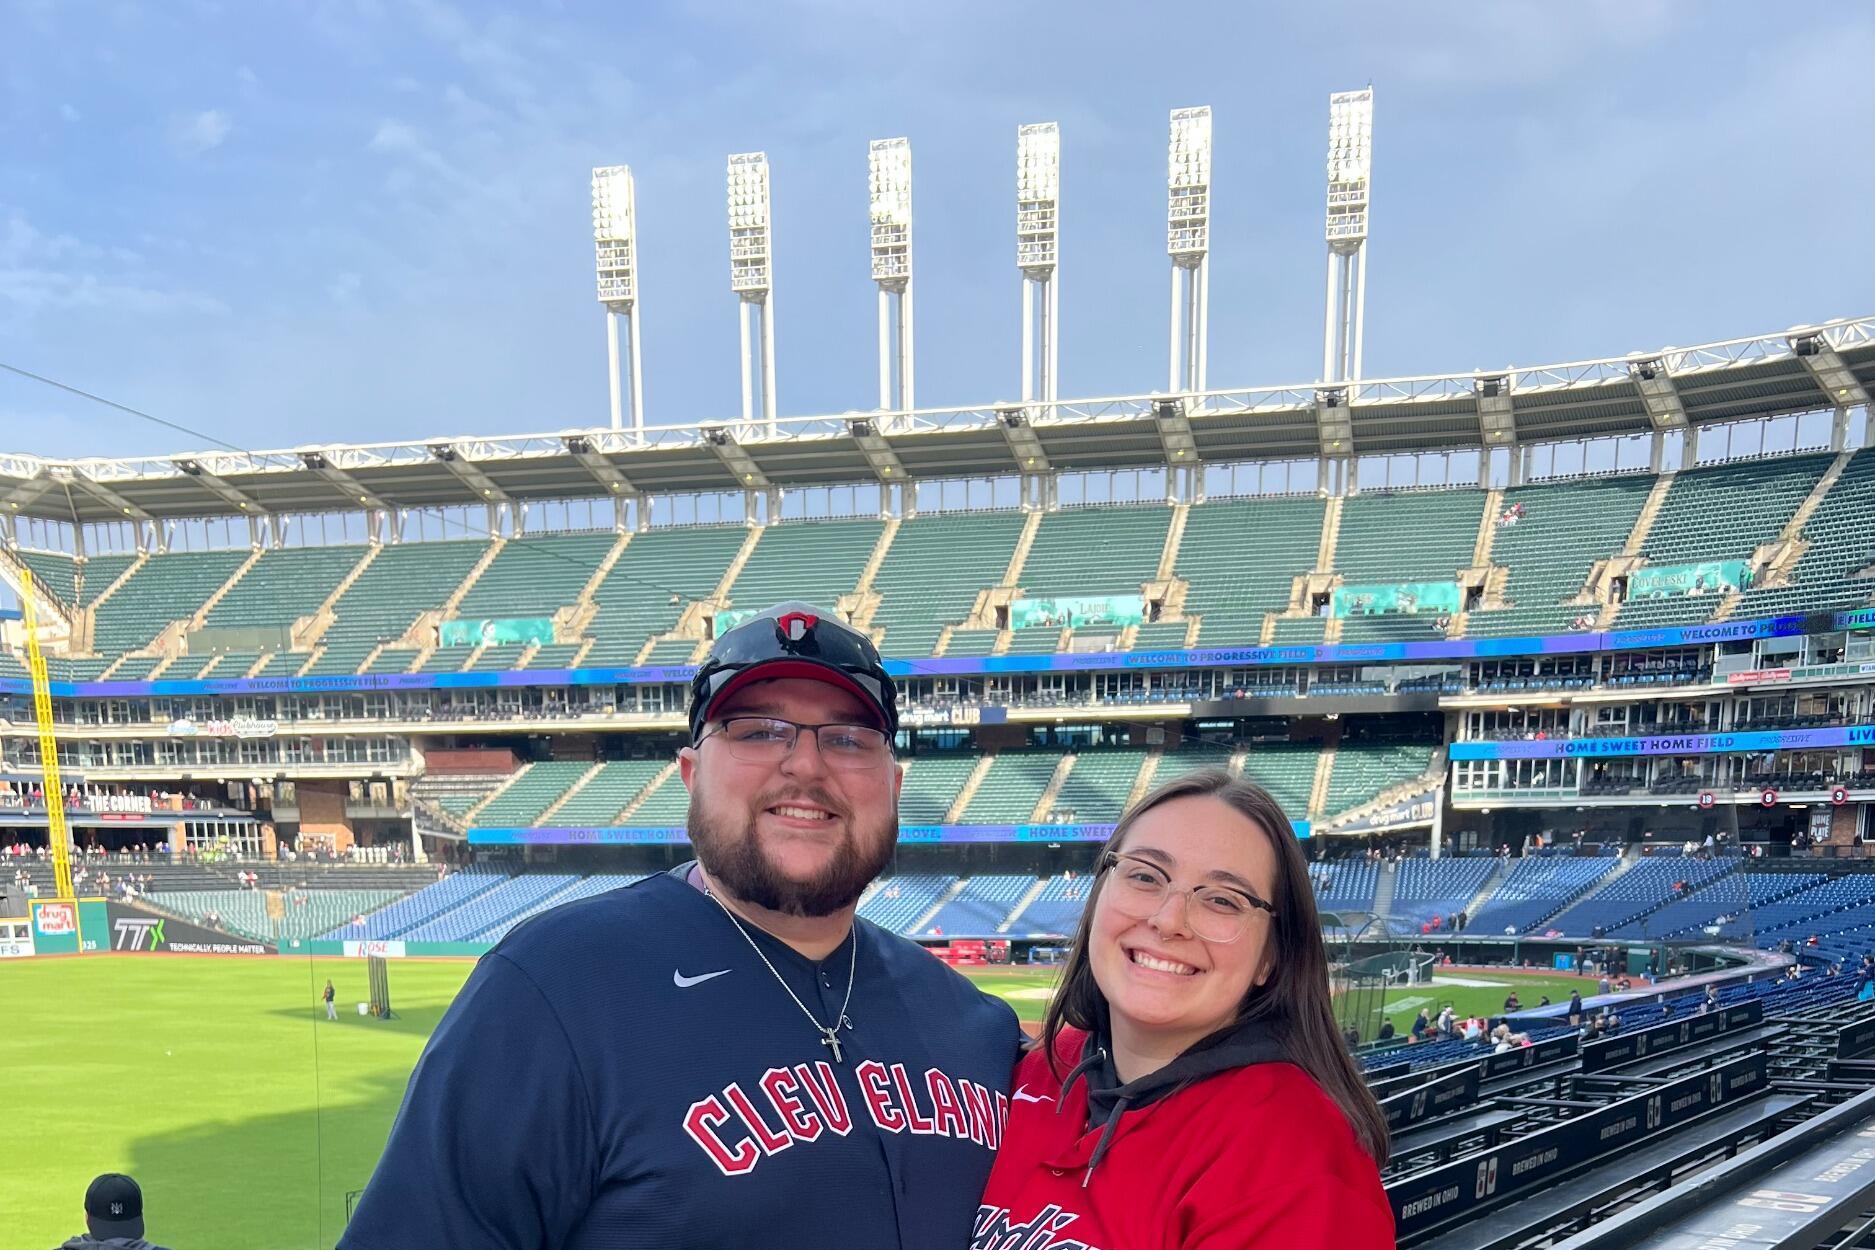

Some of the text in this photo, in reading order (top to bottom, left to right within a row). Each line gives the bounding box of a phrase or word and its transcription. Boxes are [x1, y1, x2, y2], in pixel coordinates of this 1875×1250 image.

[1680, 625, 1739, 641] WELCOME
[1741, 624, 1757, 636] TO
[1128, 654, 1180, 664] WELCOME
[1183, 653, 1198, 662] TO
[1200, 650, 1273, 662] PROGRESSIVE
[662, 668, 699, 679] WELCO
[248, 679, 288, 690] WELCOME
[290, 679, 302, 689] TO
[951, 706, 980, 724] CLUB
[1556, 737, 1734, 753] HOME SWEET HOME FIELD
[89, 795, 152, 813] THE CORNER
[1411, 801, 1434, 820] CLUB
[1811, 814, 1831, 826] HOME
[568, 830, 682, 841] HOME SWEET HOME
[1029, 826, 1069, 838] HOME
[1072, 825, 1114, 837] SWEET
[1810, 826, 1829, 838] PLATE
[39, 904, 67, 921] drug
[42, 919, 72, 931] mart
[1512, 1153, 1536, 1176] BREWED
[1544, 1147, 1558, 1164] OHIO
[1402, 1185, 1459, 1220] BREWED IN OHIO
